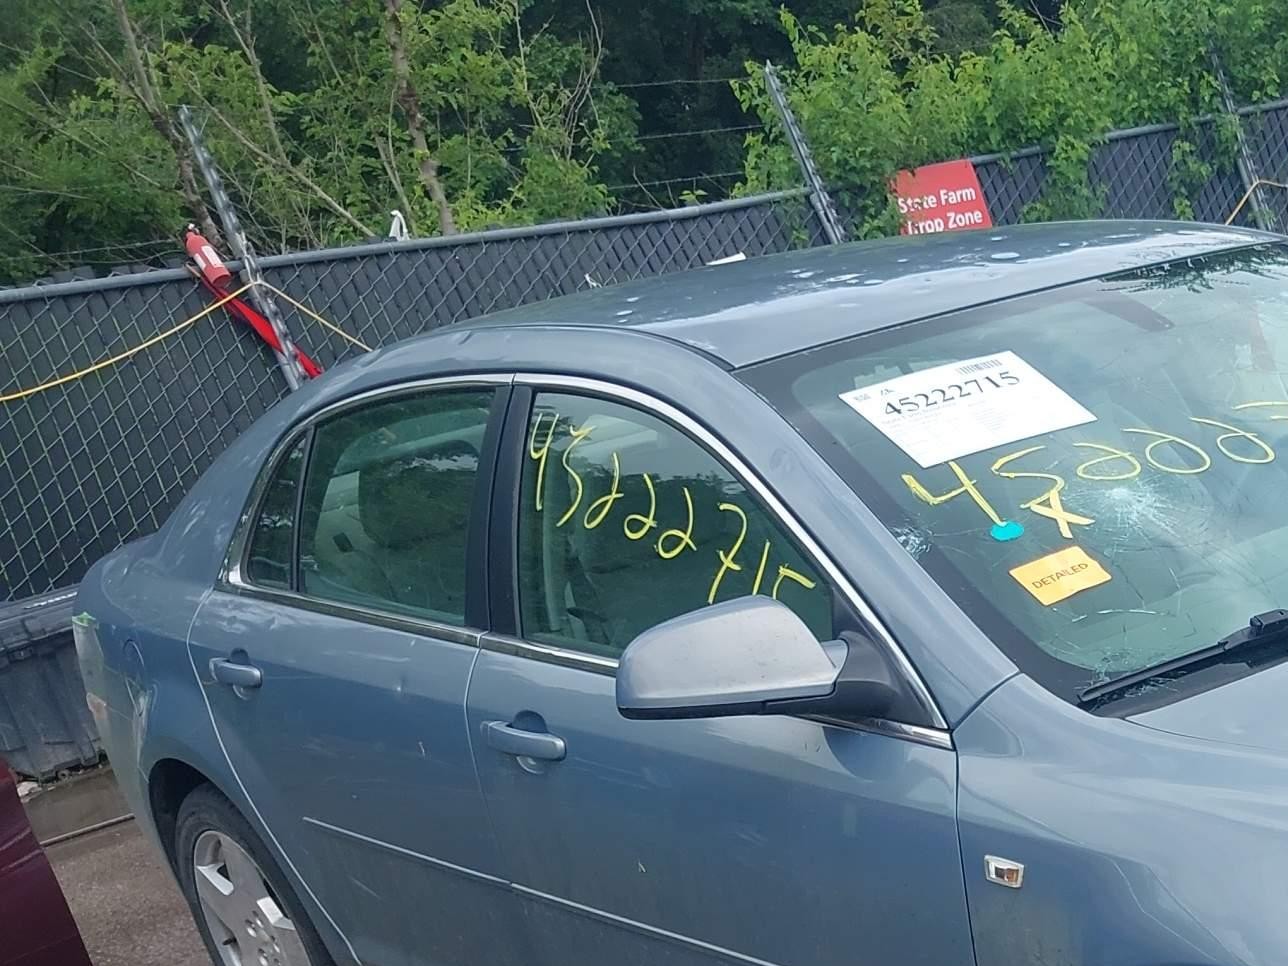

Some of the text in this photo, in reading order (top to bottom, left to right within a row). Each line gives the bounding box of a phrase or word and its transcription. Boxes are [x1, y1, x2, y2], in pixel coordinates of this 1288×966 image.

[940, 187, 976, 206] Farm
[946, 210, 983, 229] Zone
[884, 371, 1021, 416] 45222715
[1031, 563, 1089, 589] DETAILED
